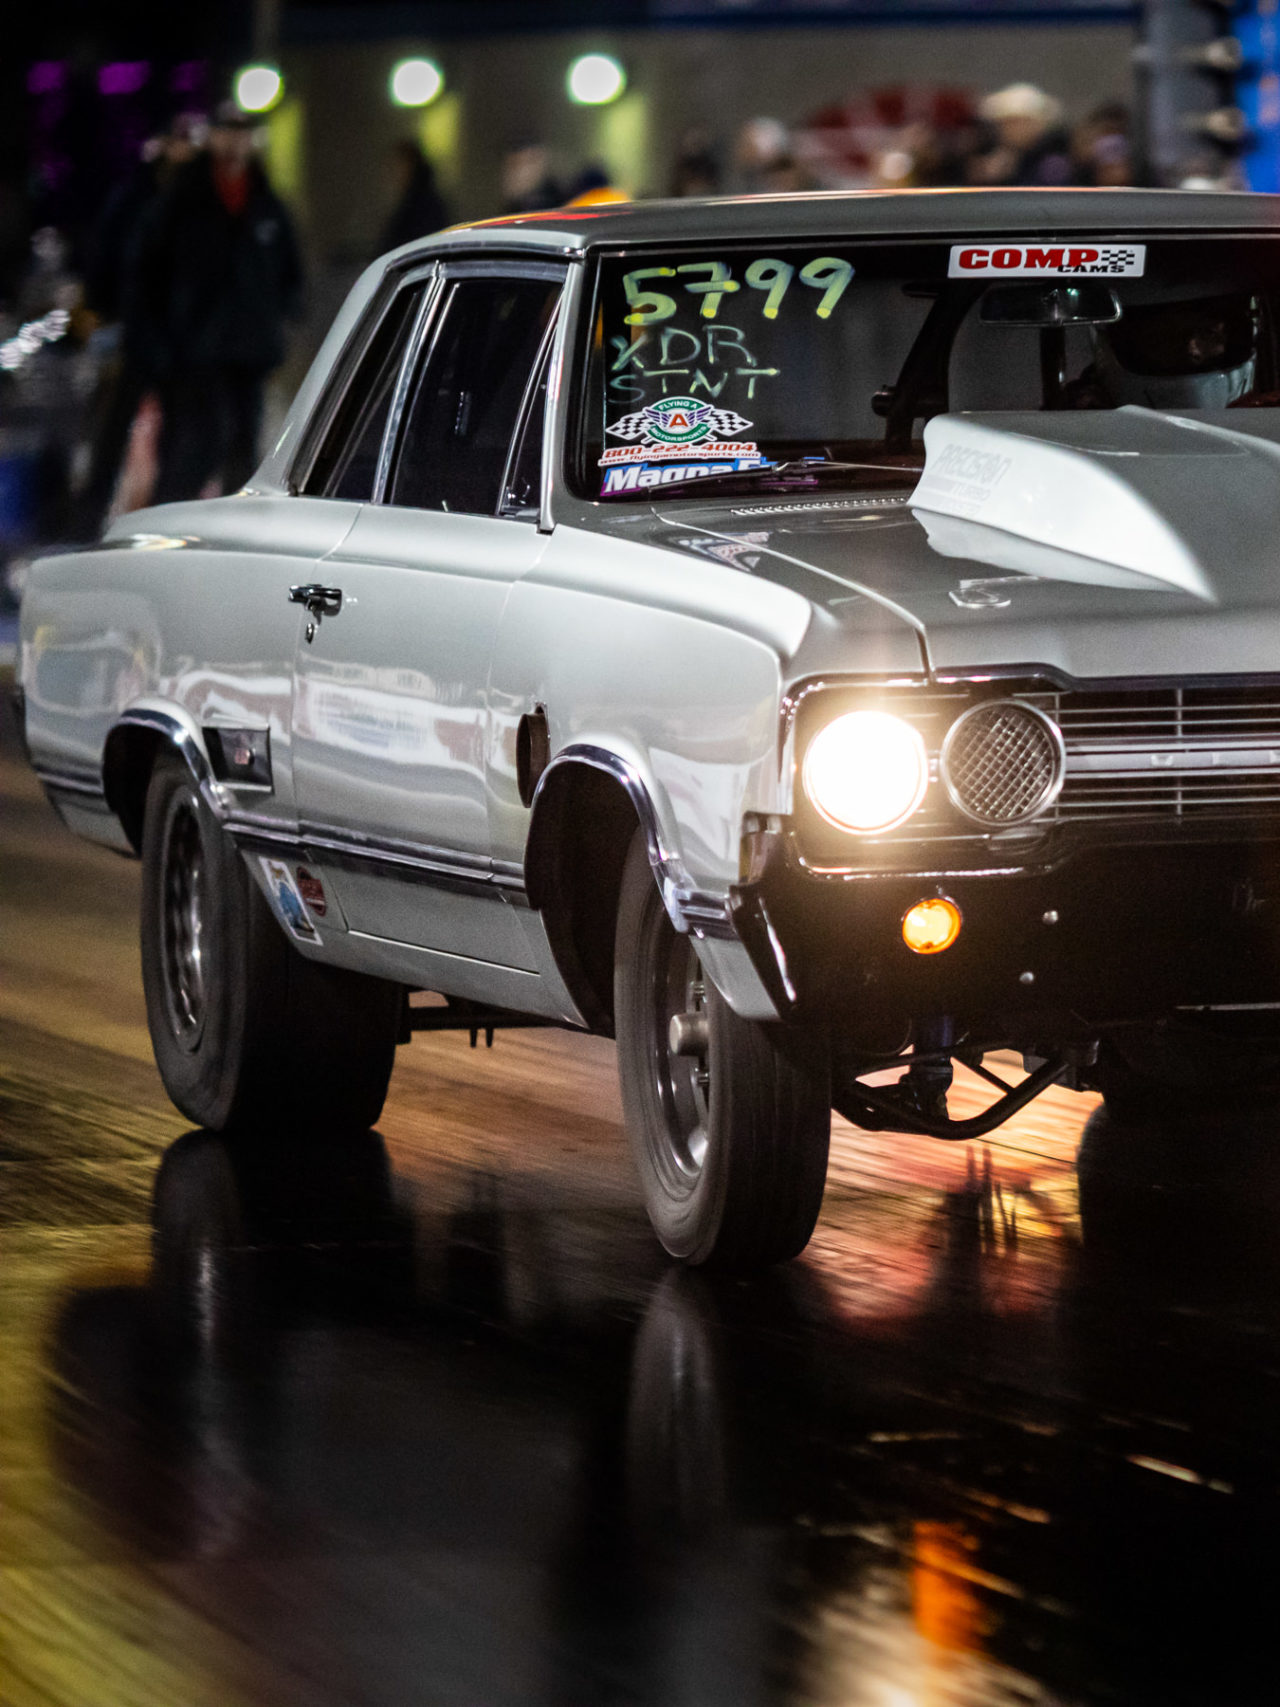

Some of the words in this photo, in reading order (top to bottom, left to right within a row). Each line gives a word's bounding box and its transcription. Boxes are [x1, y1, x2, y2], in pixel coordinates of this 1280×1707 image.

[959, 248, 1099, 270] COMP
[1057, 264, 1125, 273] CAMS
[622, 256, 856, 326] 5799
[609, 324, 758, 371] XDR
[658, 400, 690, 410] FLYING
[669, 413, 688, 427] A
[650, 426, 707, 441] MOTORSPORTS
